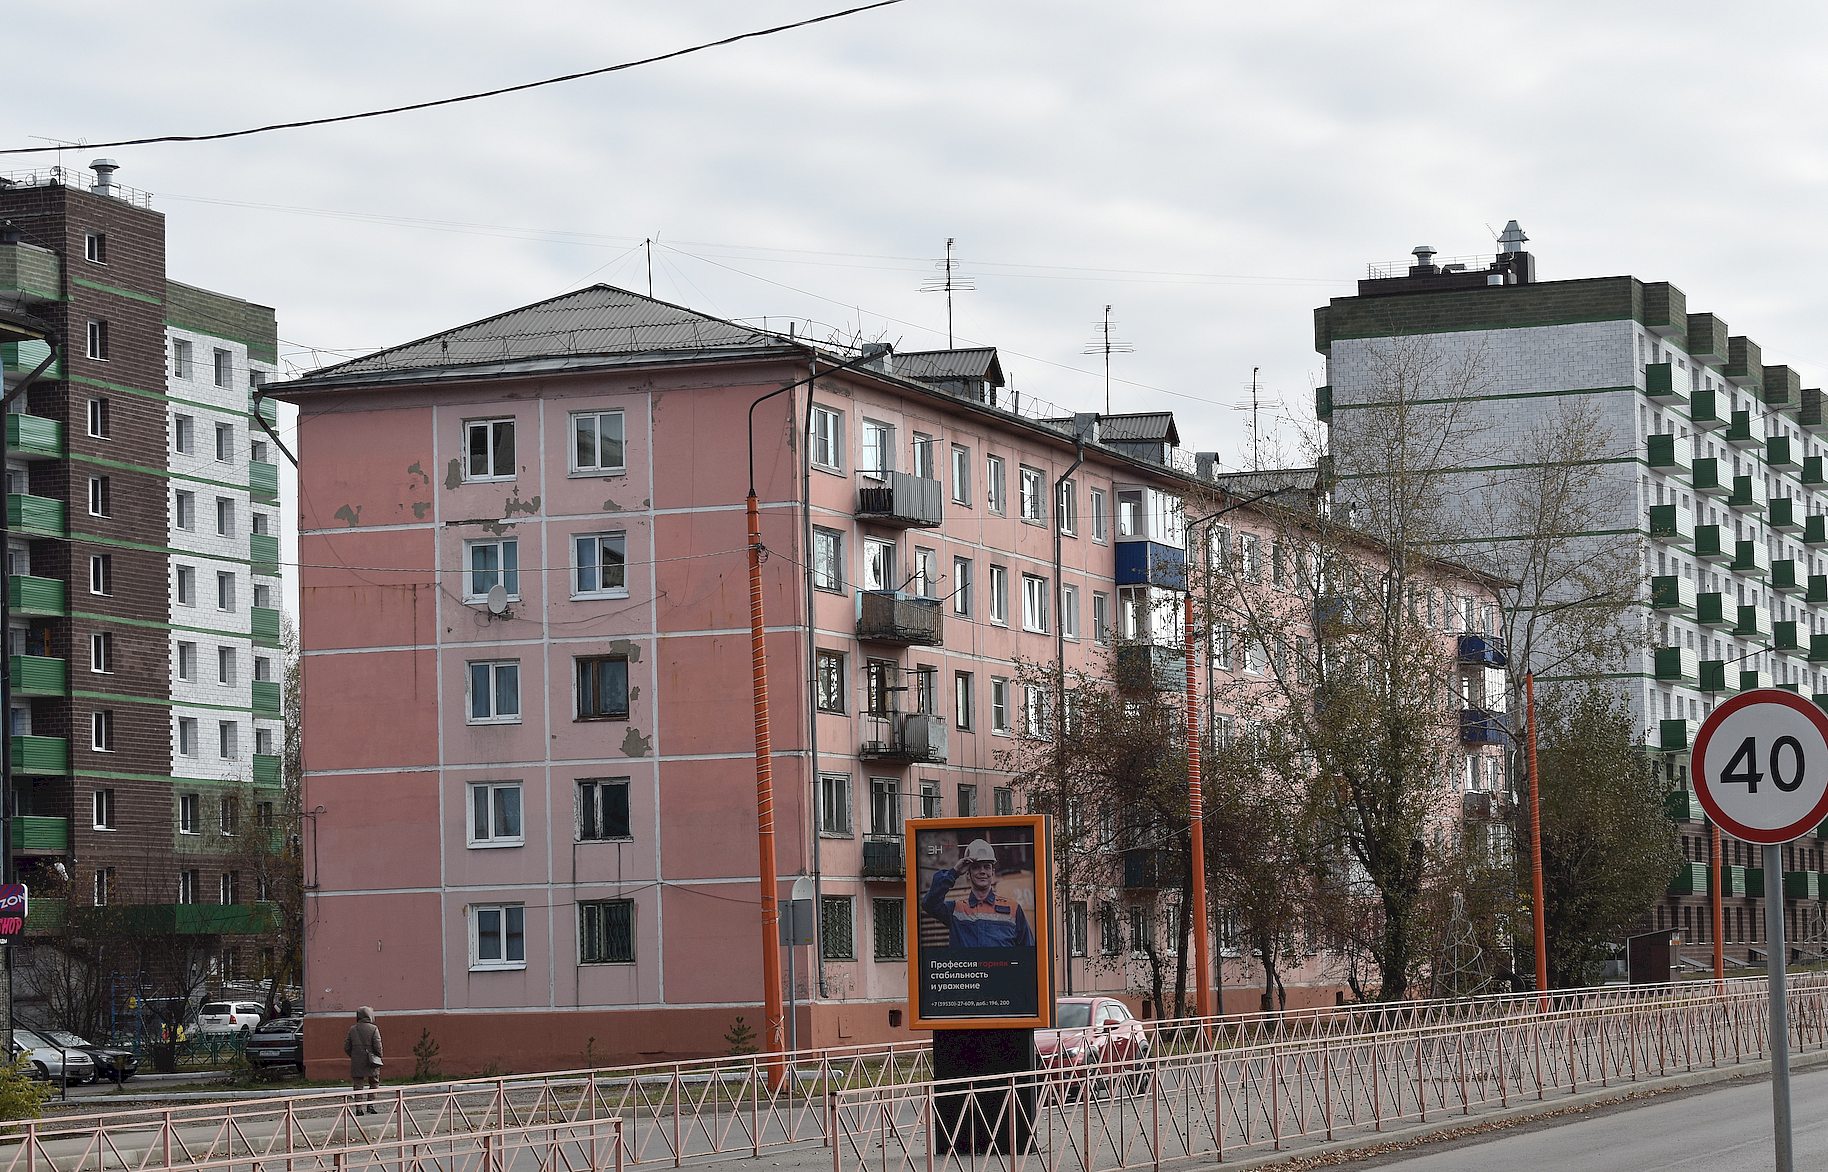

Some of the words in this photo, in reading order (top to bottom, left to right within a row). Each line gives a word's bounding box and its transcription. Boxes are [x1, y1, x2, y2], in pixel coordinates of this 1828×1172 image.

[1720, 735, 1805, 793] 40
[930, 960, 978, 970] Профессия
[930, 971, 989, 980] стабильность
[938, 982, 981, 992] уважение
